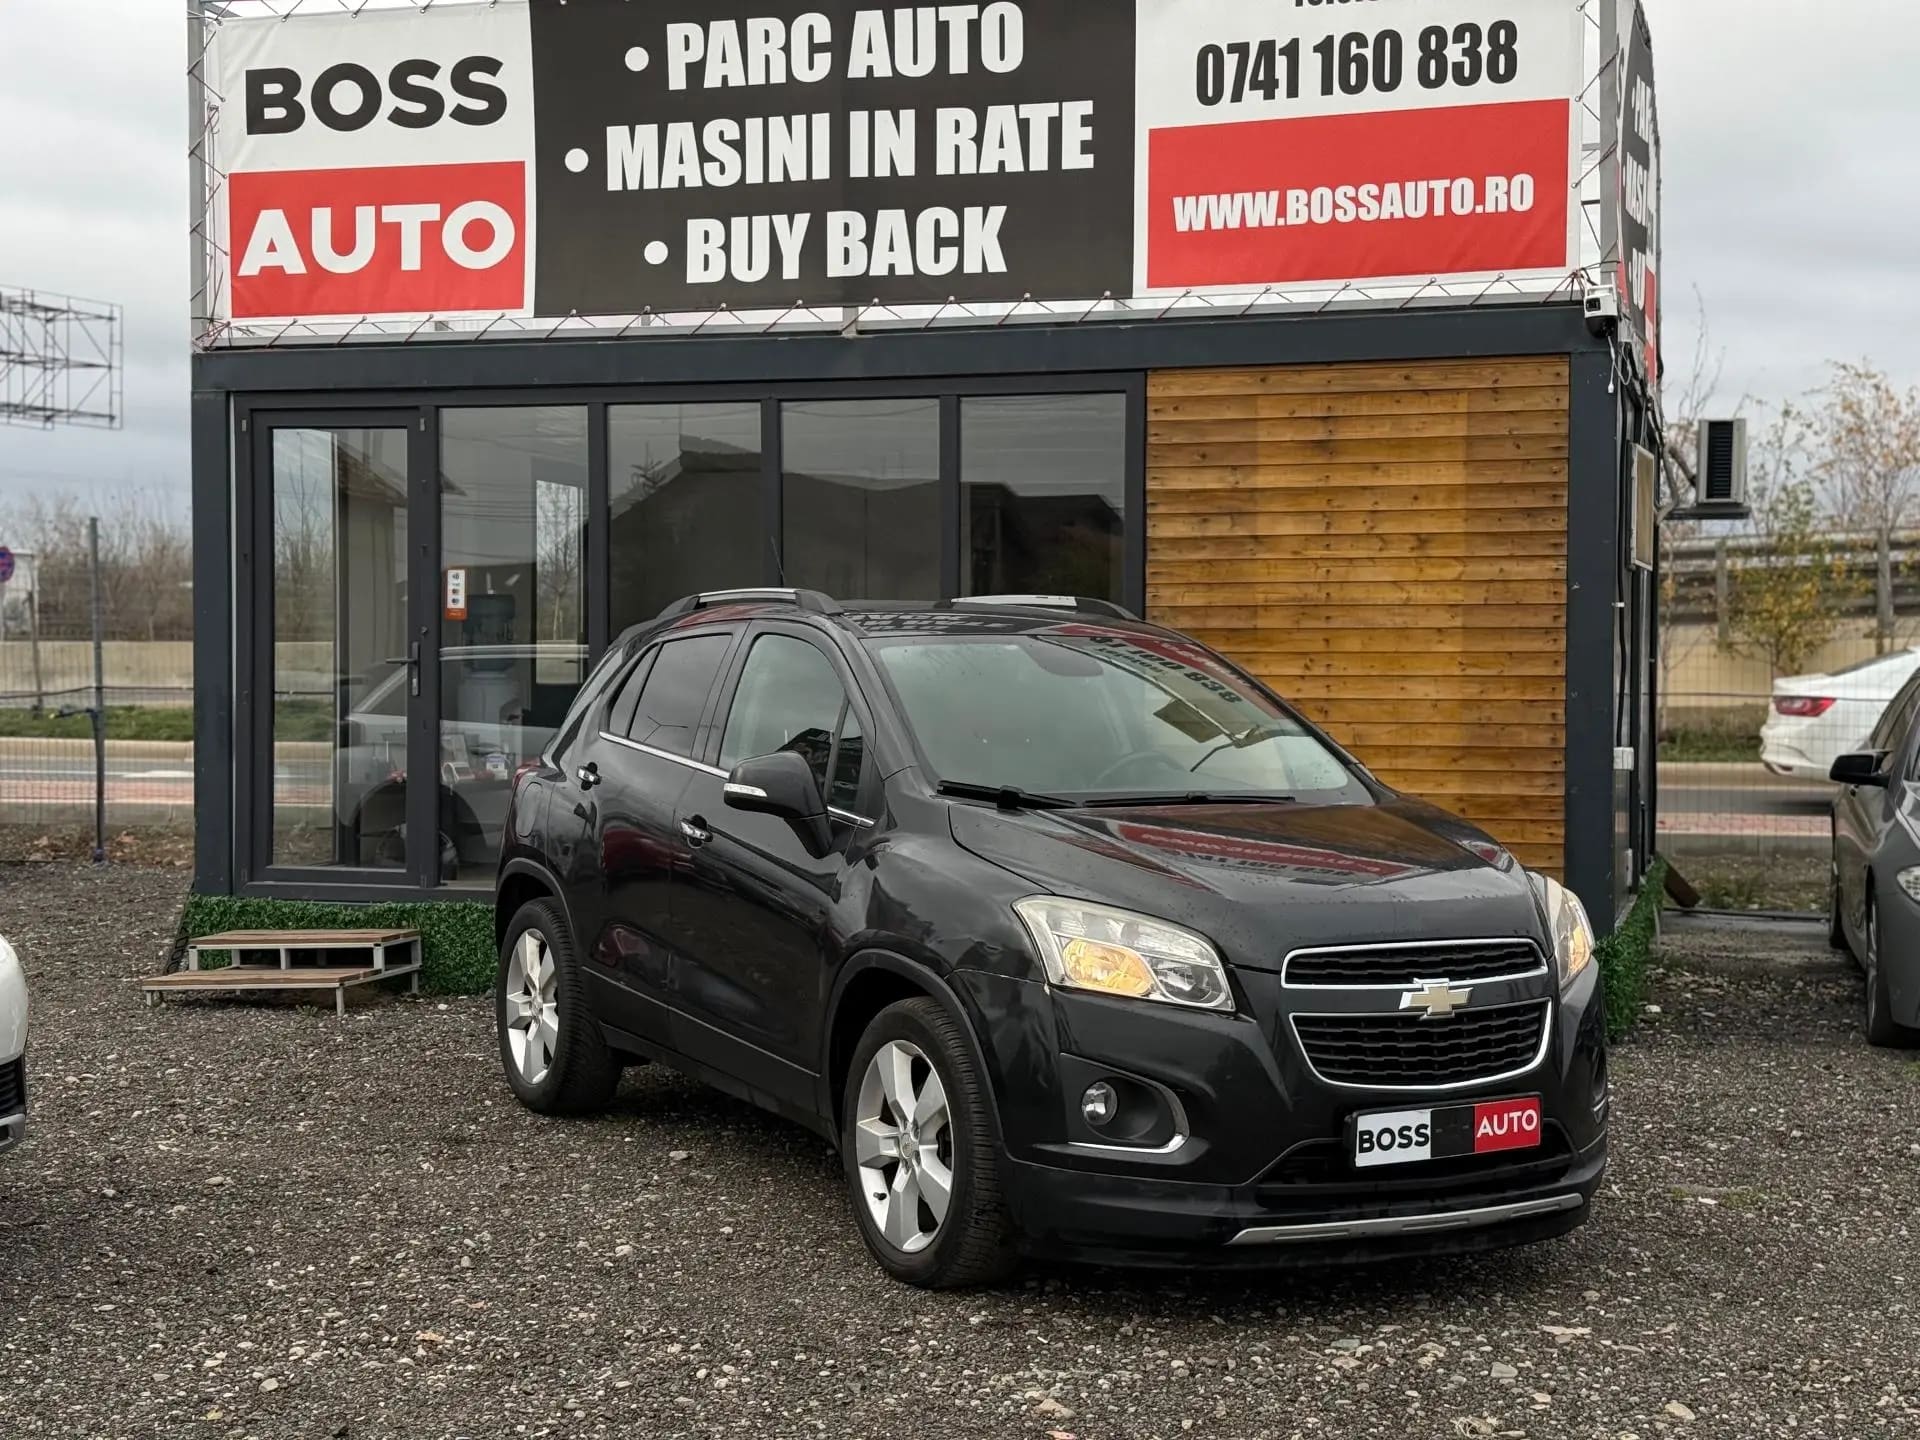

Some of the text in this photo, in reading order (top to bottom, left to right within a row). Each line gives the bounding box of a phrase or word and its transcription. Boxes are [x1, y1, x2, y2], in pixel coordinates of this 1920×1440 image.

[666, 2, 1024, 91] PARC AUTO
[1196, 20, 1518, 107] 0741 160 838
[245, 55, 507, 136] BOSS
[606, 100, 1095, 191] MASINI IN RATE
[237, 200, 516, 276] AUTO
[1172, 173, 1534, 233] WWW.BOSSAUTO.RO
[686, 205, 1008, 284] BUY BACK
[1358, 1109, 1538, 1154] BOSS AUTO
